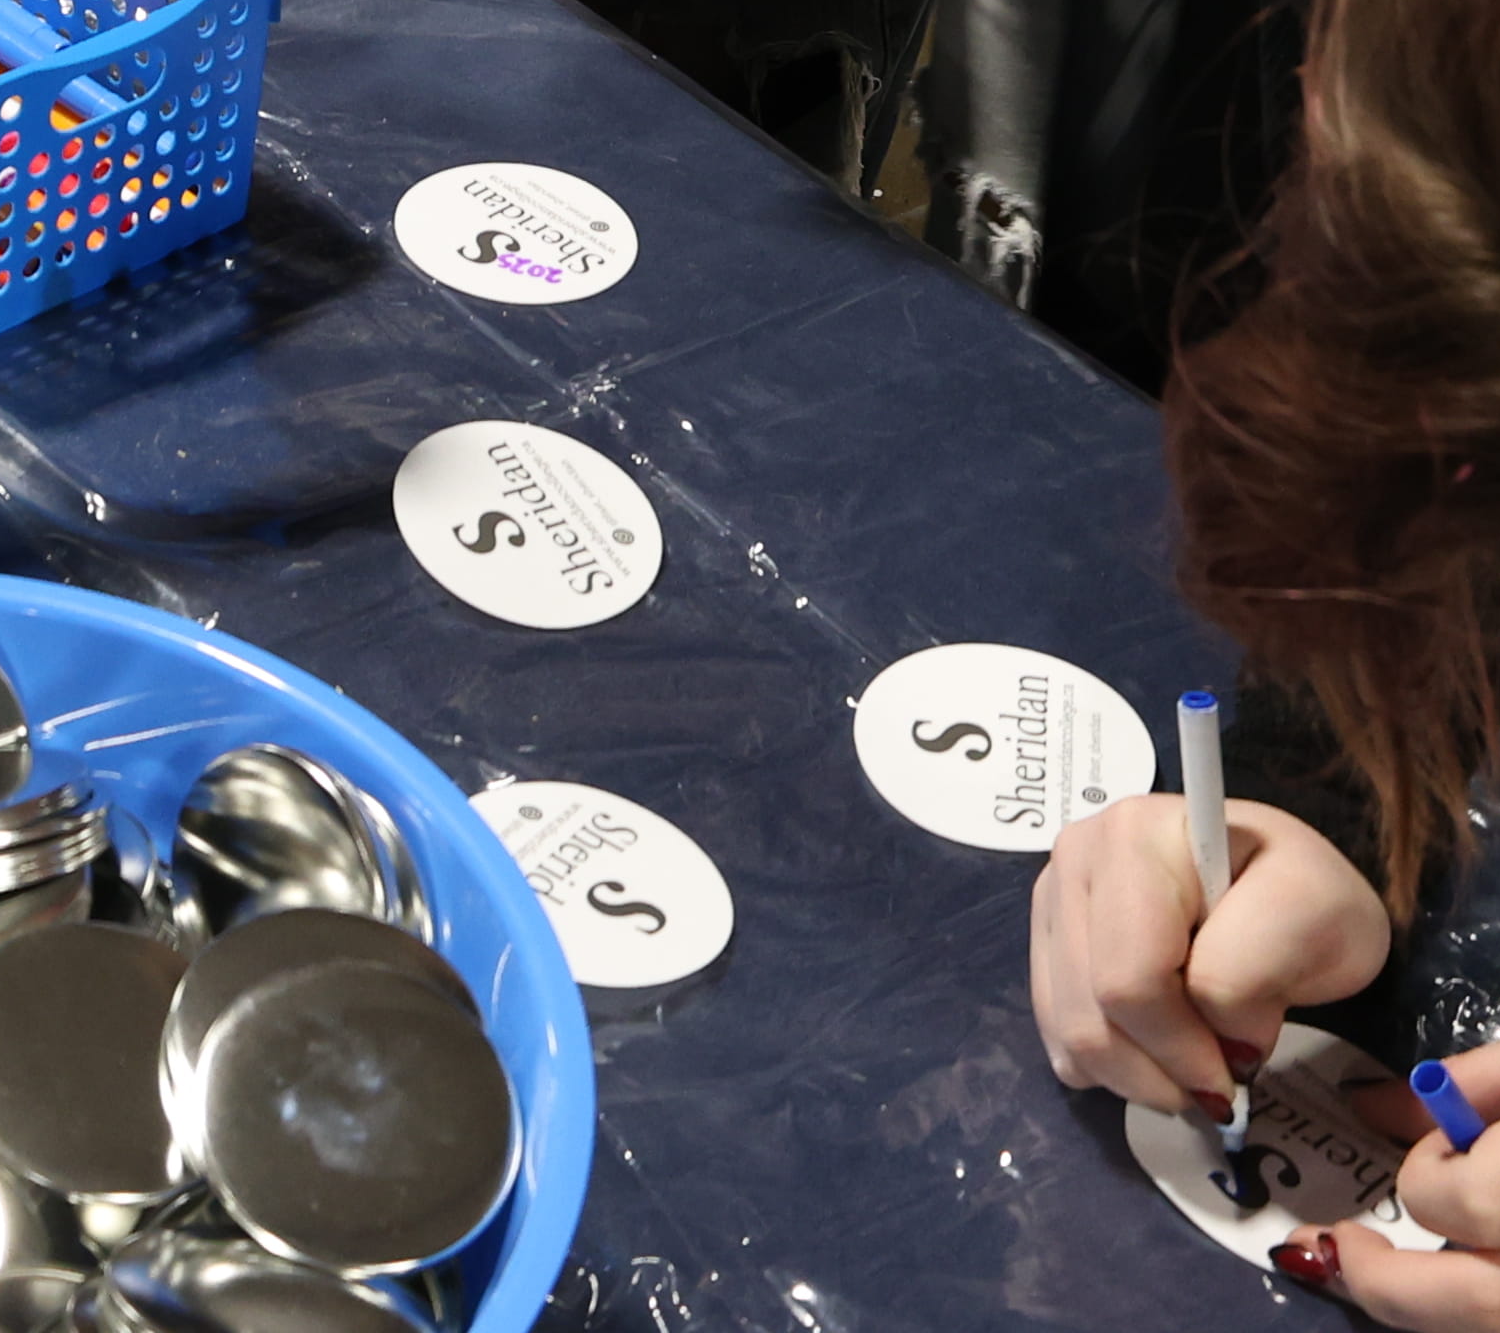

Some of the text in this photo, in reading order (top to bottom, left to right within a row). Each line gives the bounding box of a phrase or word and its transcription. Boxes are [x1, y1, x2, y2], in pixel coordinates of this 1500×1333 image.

[456, 230, 521, 264] S
[463, 179, 606, 275] Sheridan
[453, 511, 526, 555] S
[487, 439, 614, 595] Sheridan
[911, 720, 992, 761] S
[993, 675, 1049, 828] Sheridan
[525, 813, 638, 906] Sherid
[587, 880, 666, 935] S
